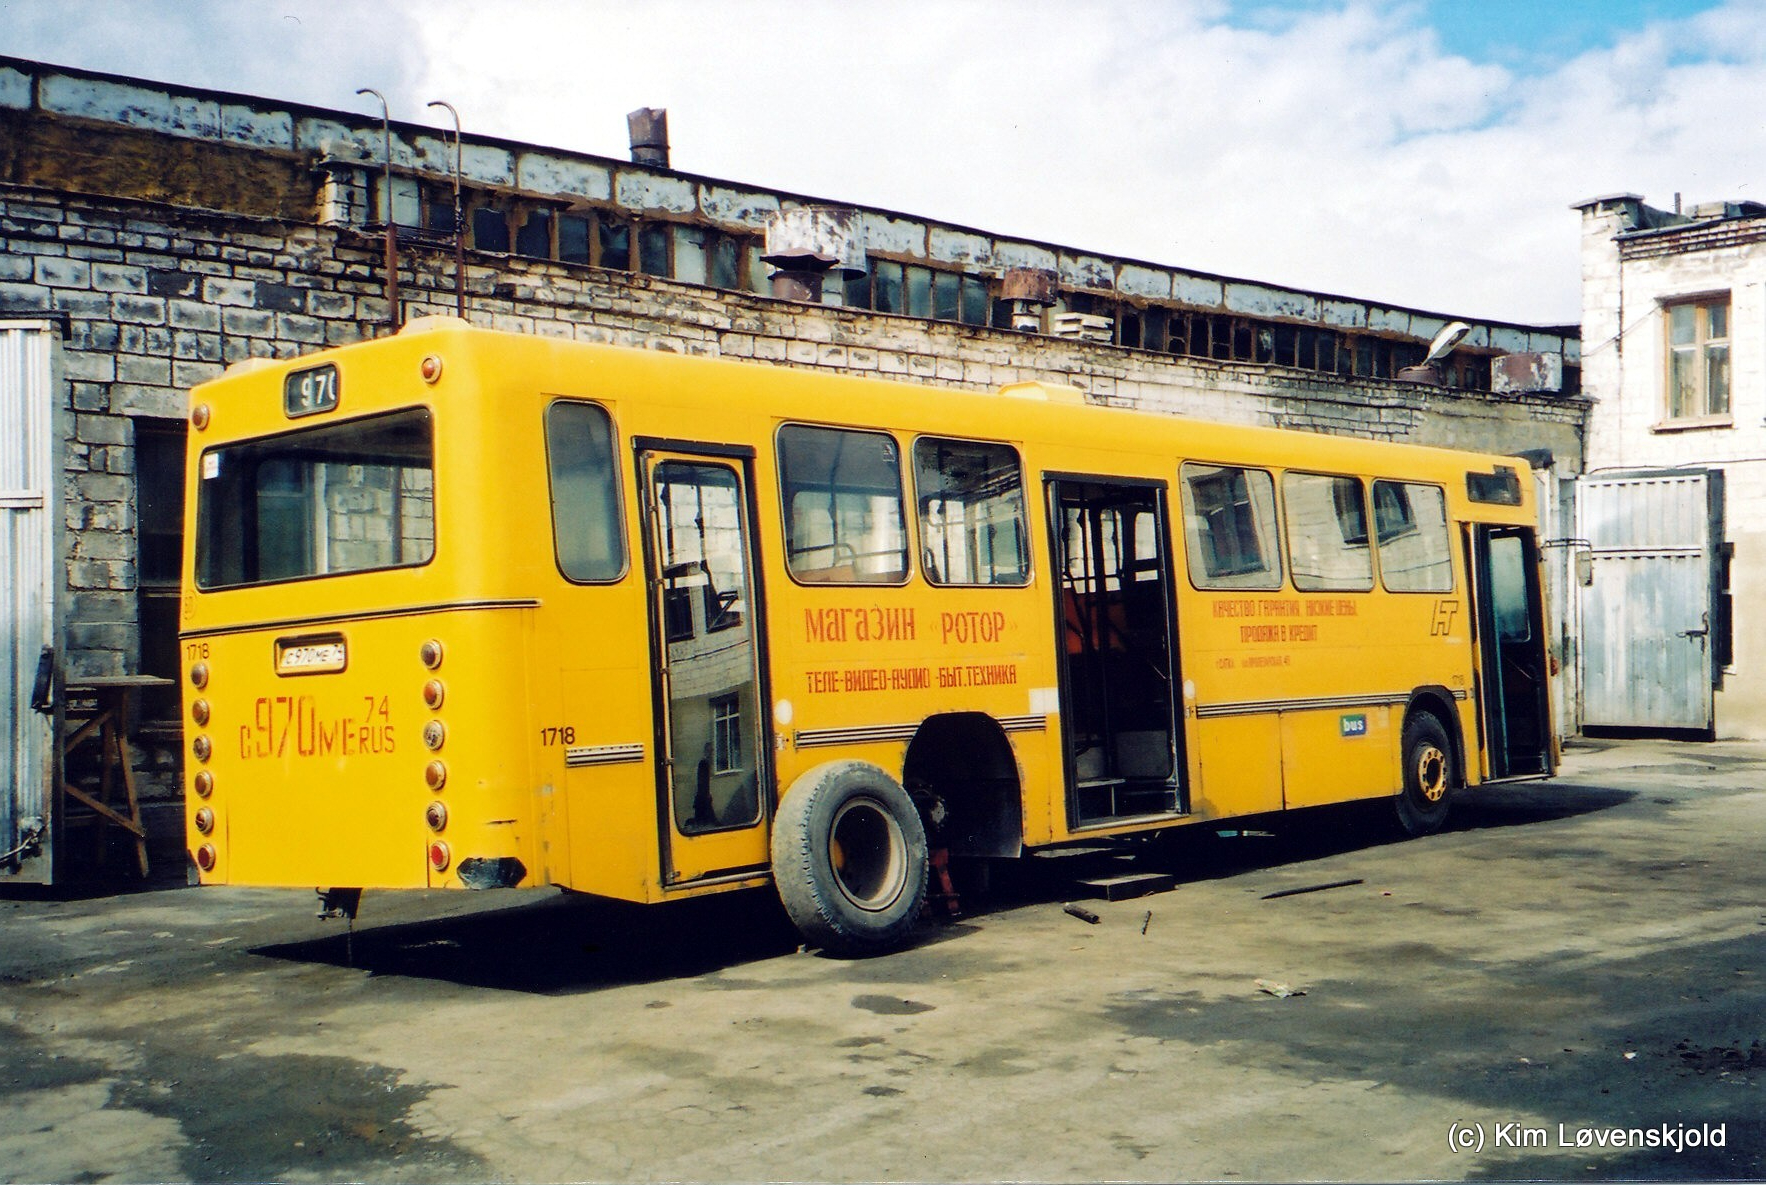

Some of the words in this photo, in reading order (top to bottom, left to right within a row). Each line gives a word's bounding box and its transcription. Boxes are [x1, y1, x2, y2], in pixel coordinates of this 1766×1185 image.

[187, 643, 210, 660] 1718
[364, 695, 389, 723] 74
[1343, 718, 1364, 732] bus
[359, 725, 395, 753] RUS
[541, 727, 576, 746] 1718
